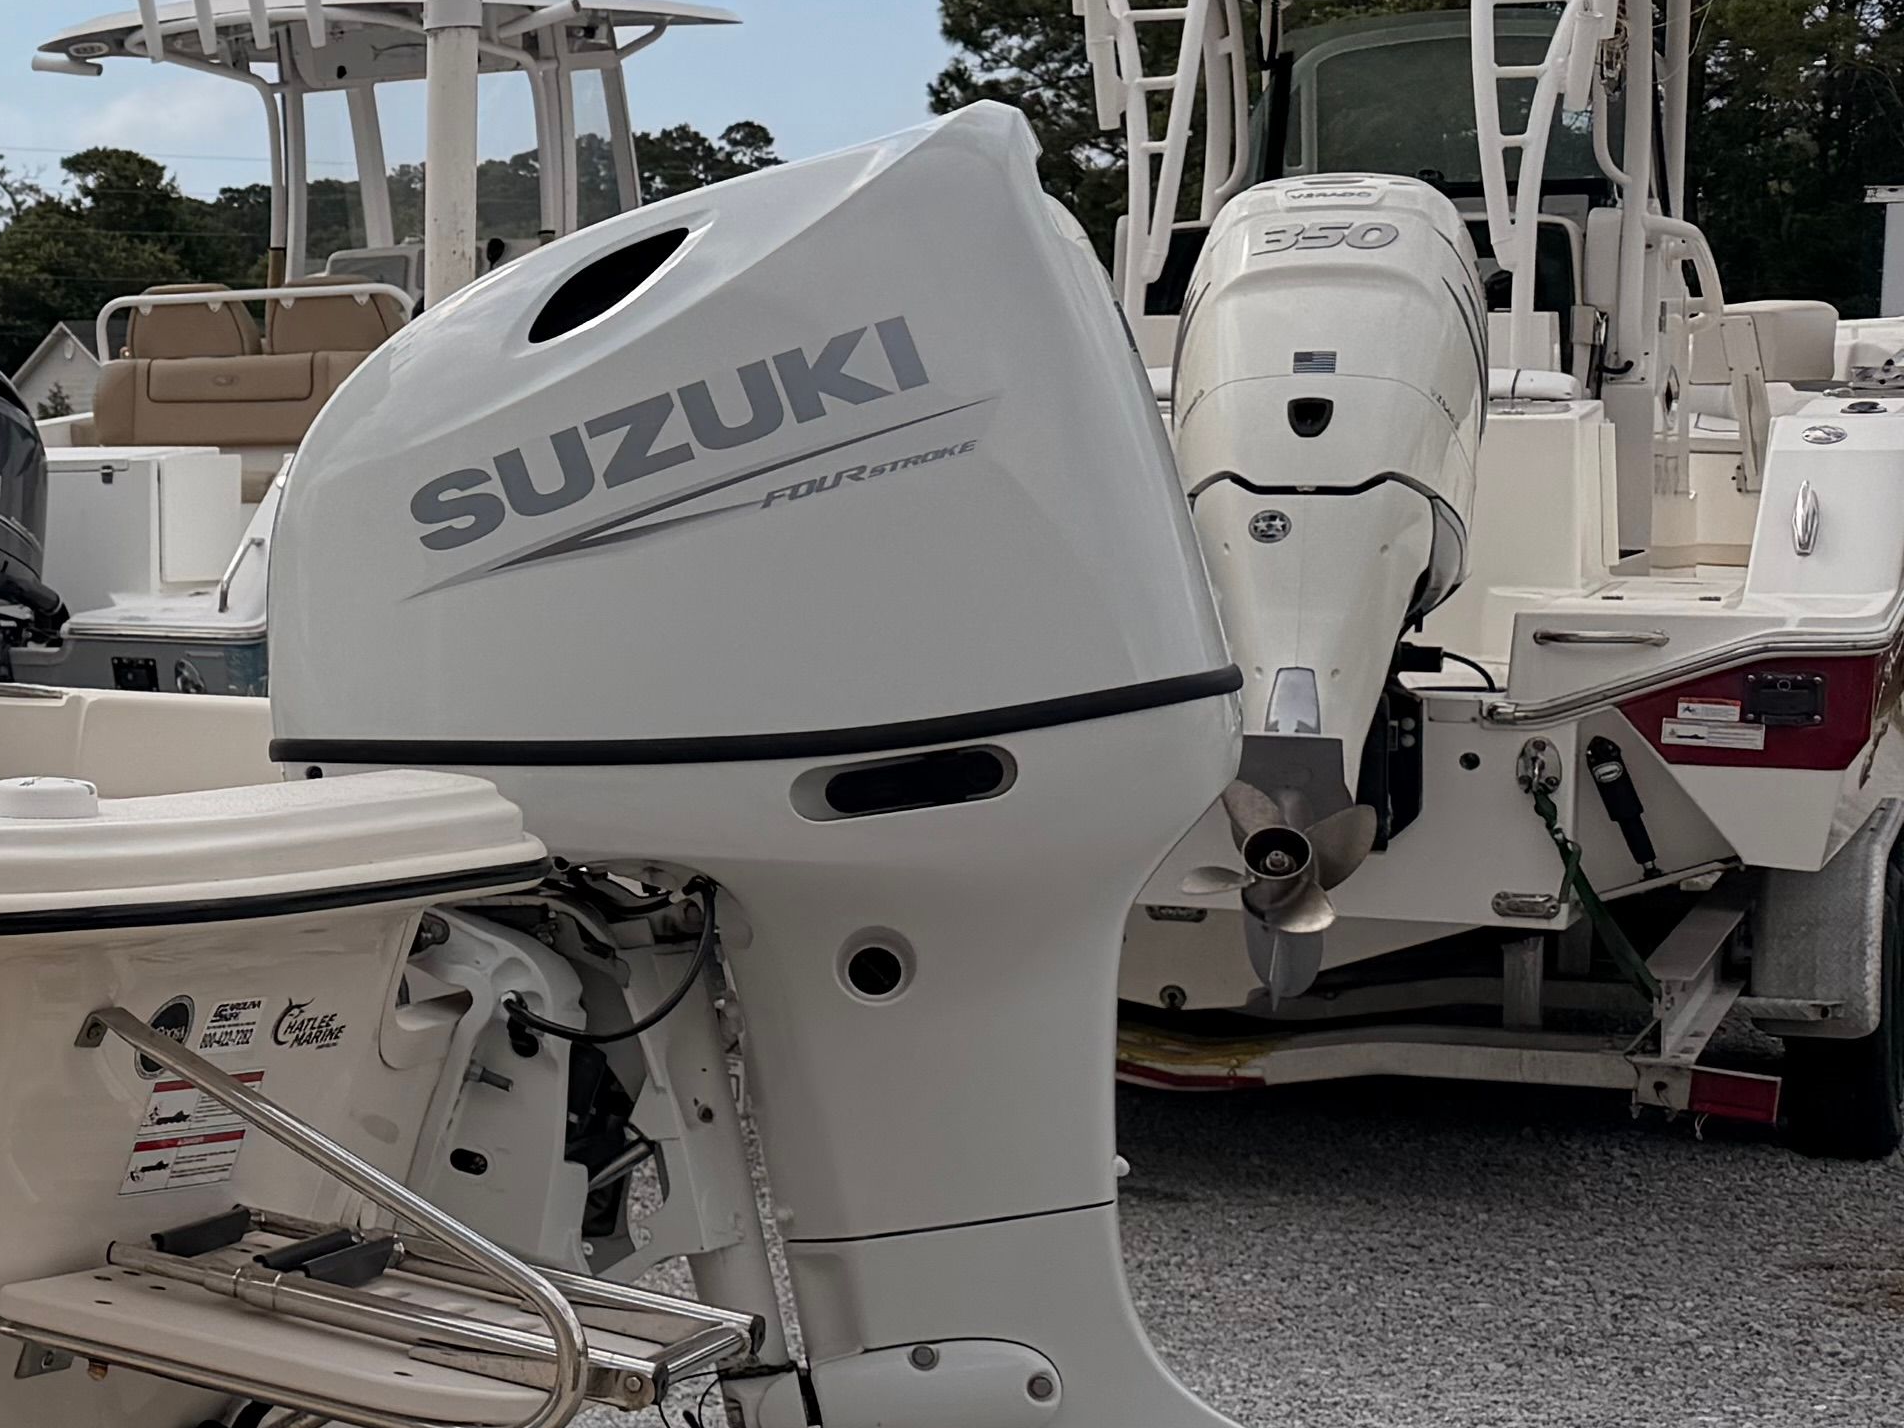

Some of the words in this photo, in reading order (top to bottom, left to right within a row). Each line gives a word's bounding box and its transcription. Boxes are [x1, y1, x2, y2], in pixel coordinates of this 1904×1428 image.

[1290, 191, 1372, 200] VERADO
[1252, 222, 1400, 257] 350
[409, 315, 930, 552] SUZUKI
[271, 998, 337, 1046] CHATLEE
[289, 1025, 346, 1049] MARINE
